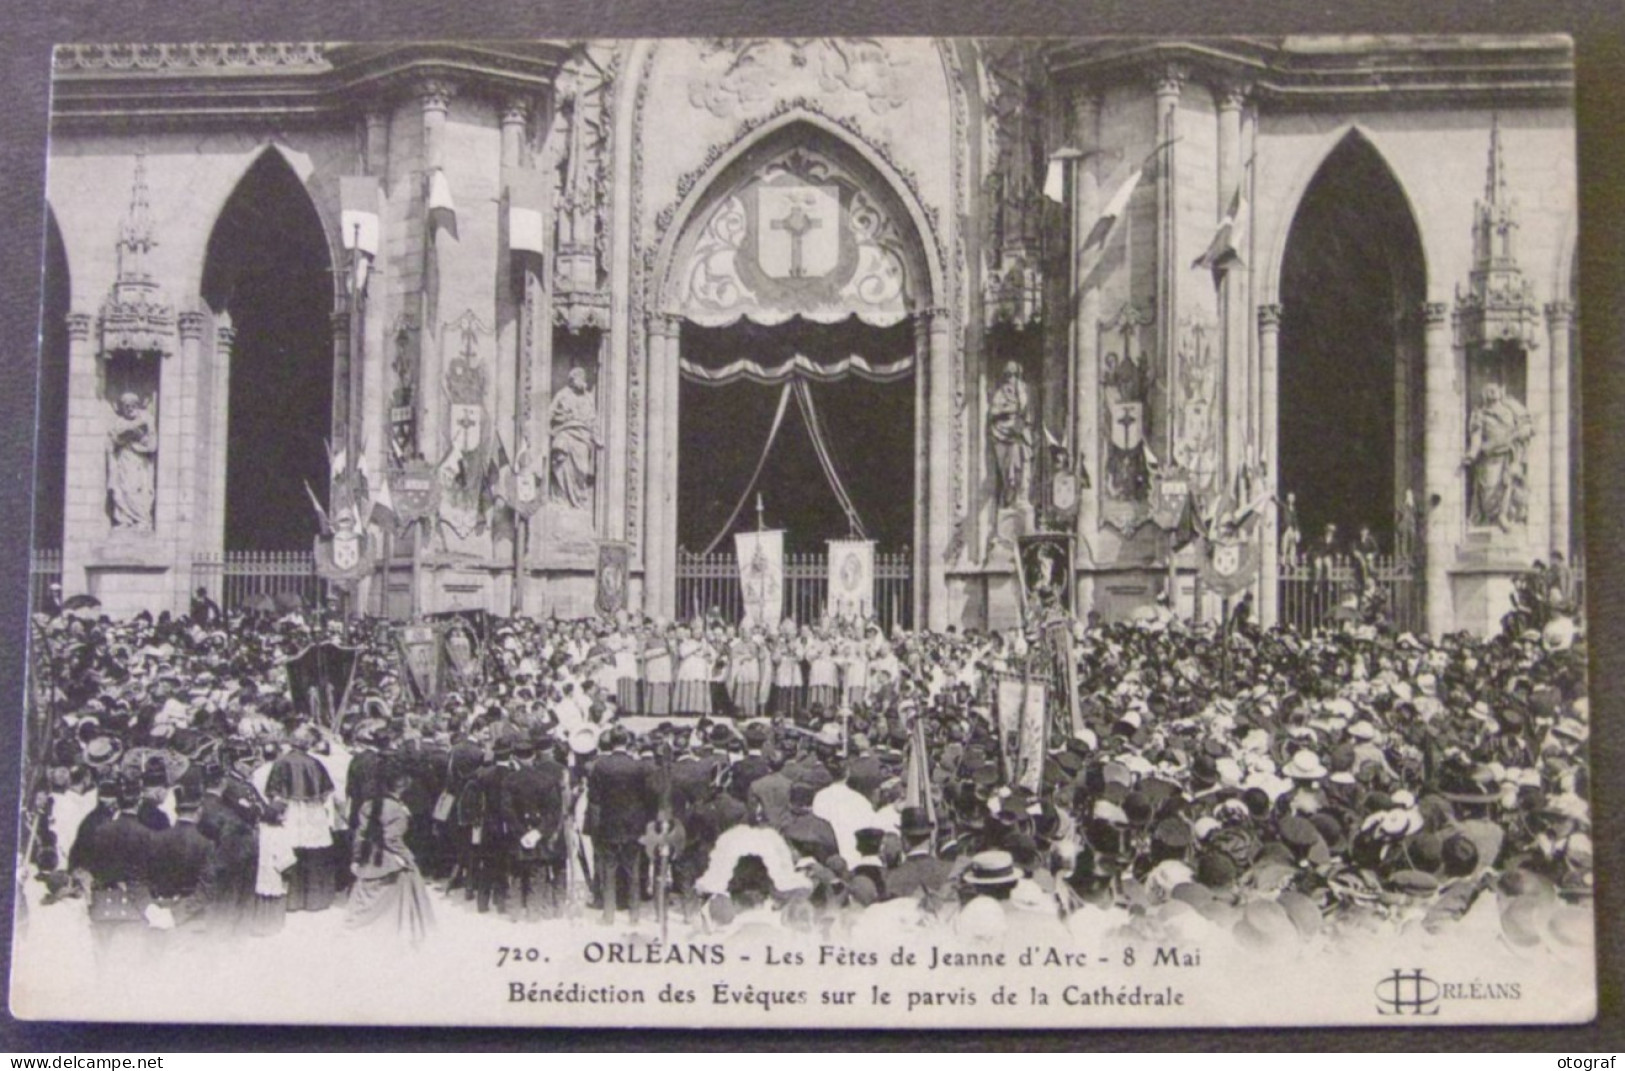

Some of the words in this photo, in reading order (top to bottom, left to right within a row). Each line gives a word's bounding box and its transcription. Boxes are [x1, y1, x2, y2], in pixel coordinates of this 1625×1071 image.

[496, 946, 550, 968] 720.
[584, 937, 725, 965] ORLÉANS
[765, 946, 804, 965] Les
[890, 946, 916, 966] de
[929, 946, 1005, 969] Jeanne
[1019, 947, 1086, 967] d'Arc
[1123, 947, 1135, 967] 8
[1153, 947, 1200, 966] Mai
[508, 982, 644, 1003] Bénédiction
[658, 983, 695, 1003] des
[821, 991, 856, 1005] sur
[872, 985, 890, 1005] le
[908, 988, 976, 1011] parvis
[991, 985, 1017, 1005] de
[1031, 987, 1048, 1005] la
[1062, 985, 1183, 1006] Cathédrale
